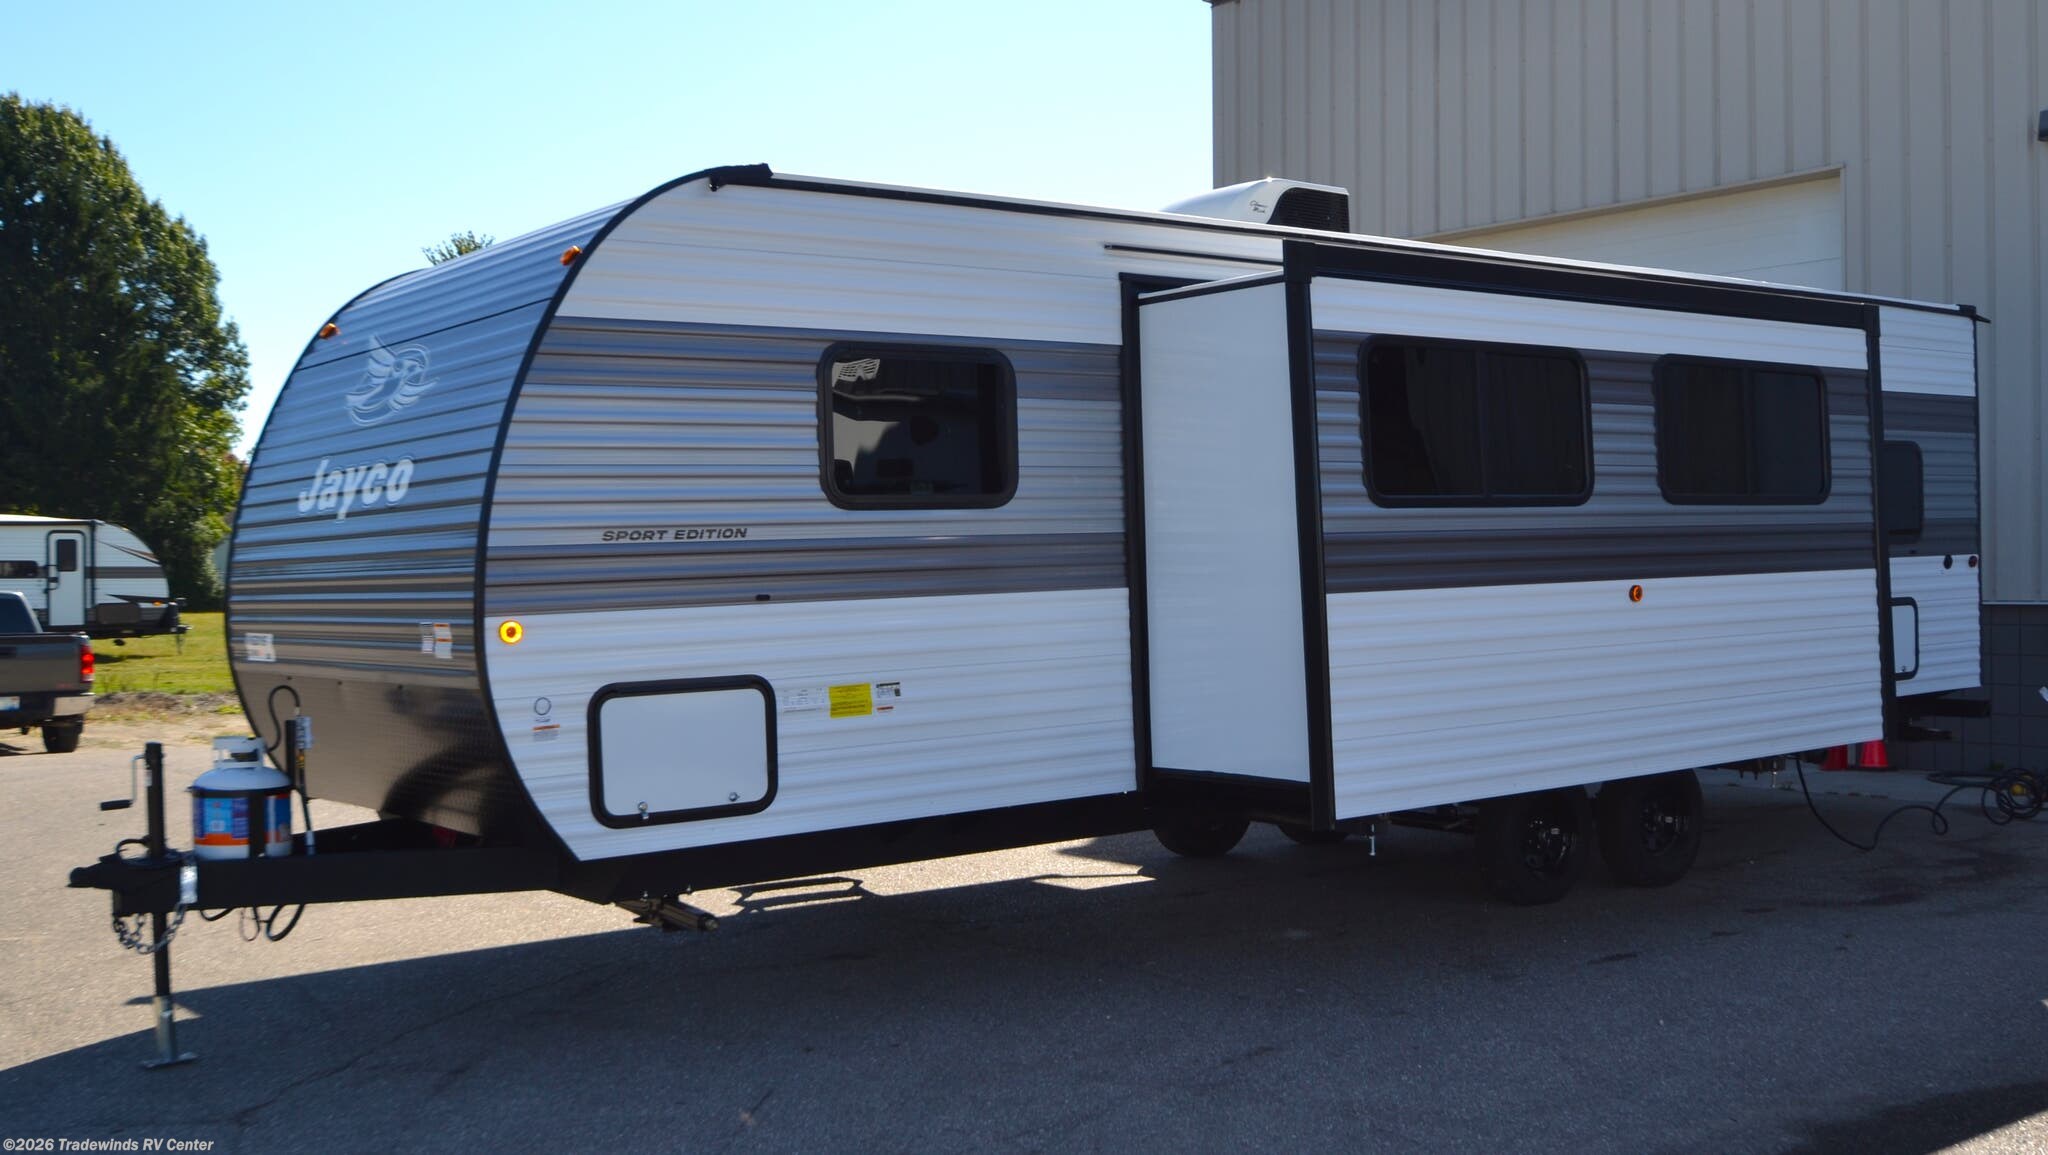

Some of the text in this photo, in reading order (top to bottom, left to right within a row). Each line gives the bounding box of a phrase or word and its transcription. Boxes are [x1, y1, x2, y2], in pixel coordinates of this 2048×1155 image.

[297, 458, 414, 521] Jayco
[602, 528, 748, 542] SPORT EDITION
